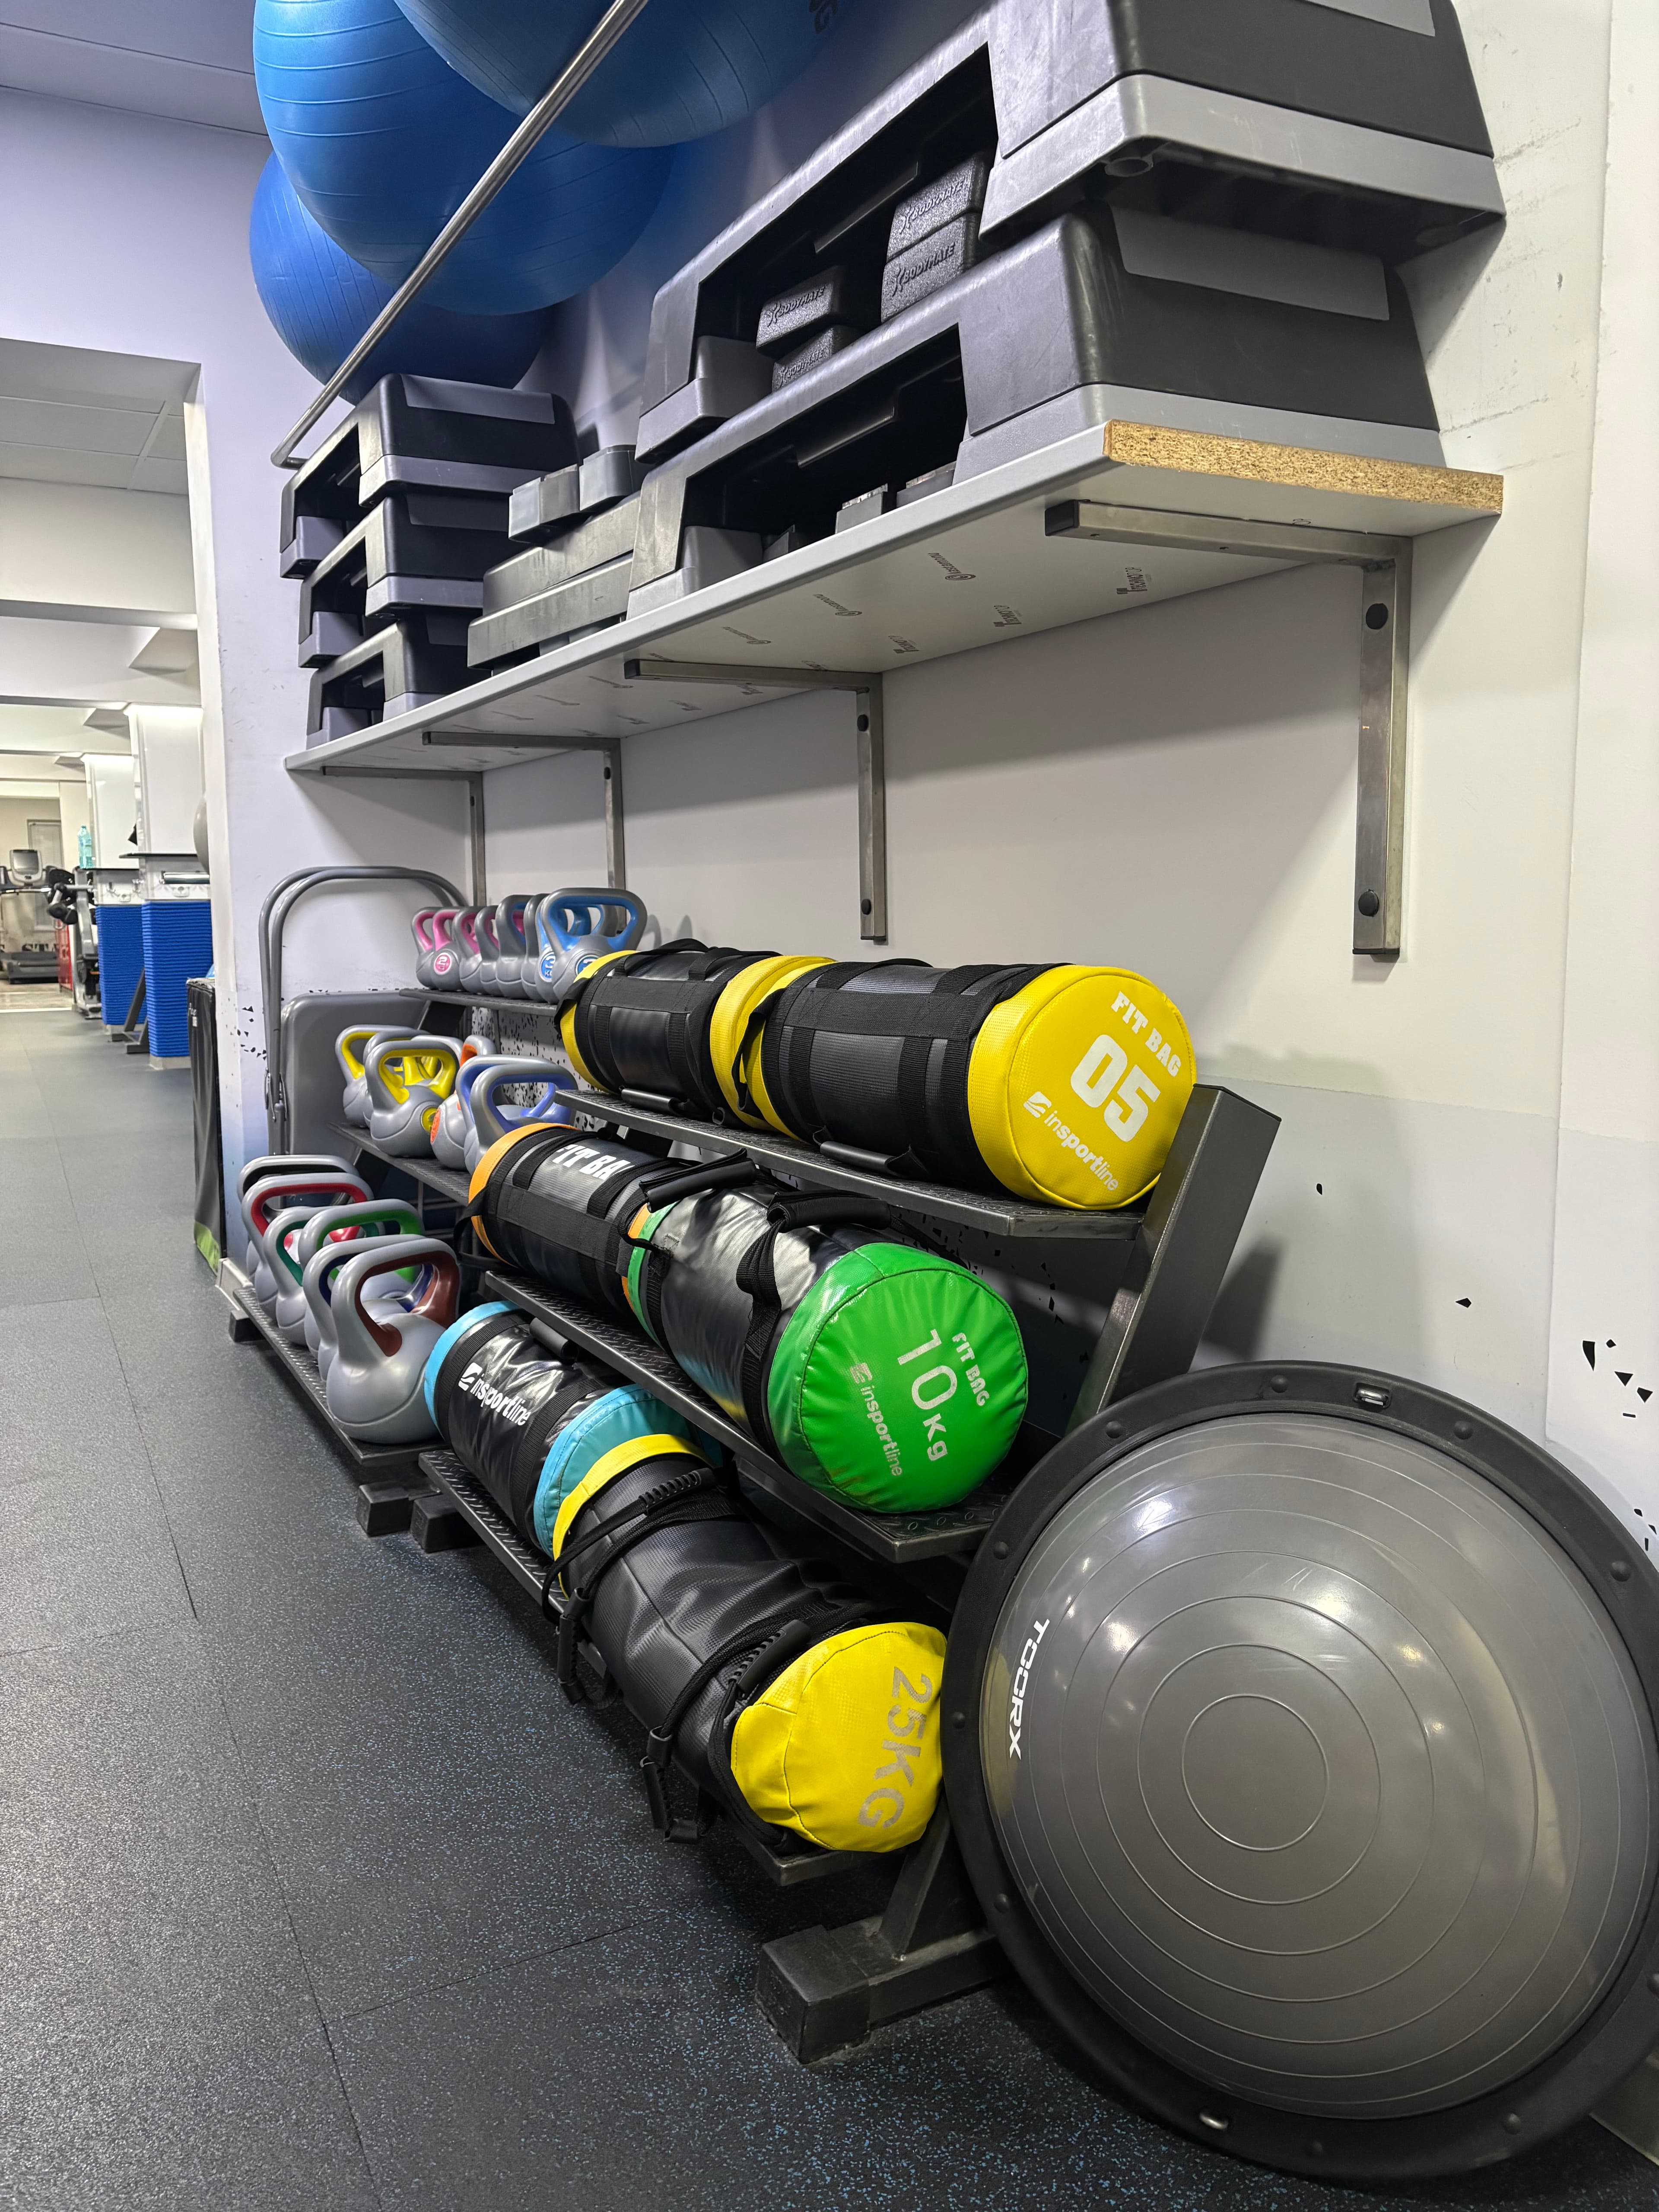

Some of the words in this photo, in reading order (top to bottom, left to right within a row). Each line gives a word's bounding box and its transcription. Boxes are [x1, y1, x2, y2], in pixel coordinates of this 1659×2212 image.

[902, 242, 955, 284] BODYMATE
[778, 285, 826, 318] BODYMATE
[438, 956, 447, 966] 2
[545, 956, 556, 969] 3
[1111, 991, 1148, 1034] FIT
[1145, 1028, 1181, 1077] BAG
[1070, 1034, 1161, 1142] 05
[579, 1155, 636, 1180] BA
[1044, 1110, 1119, 1191] insportline
[470, 1373, 531, 1426] insportline
[952, 1332, 975, 1362] FIT
[966, 1364, 990, 1406] BAG
[860, 1385, 903, 1476] insportline
[1009, 1619, 1050, 1760] TOORX
[857, 1666, 933, 1828] 25KG
